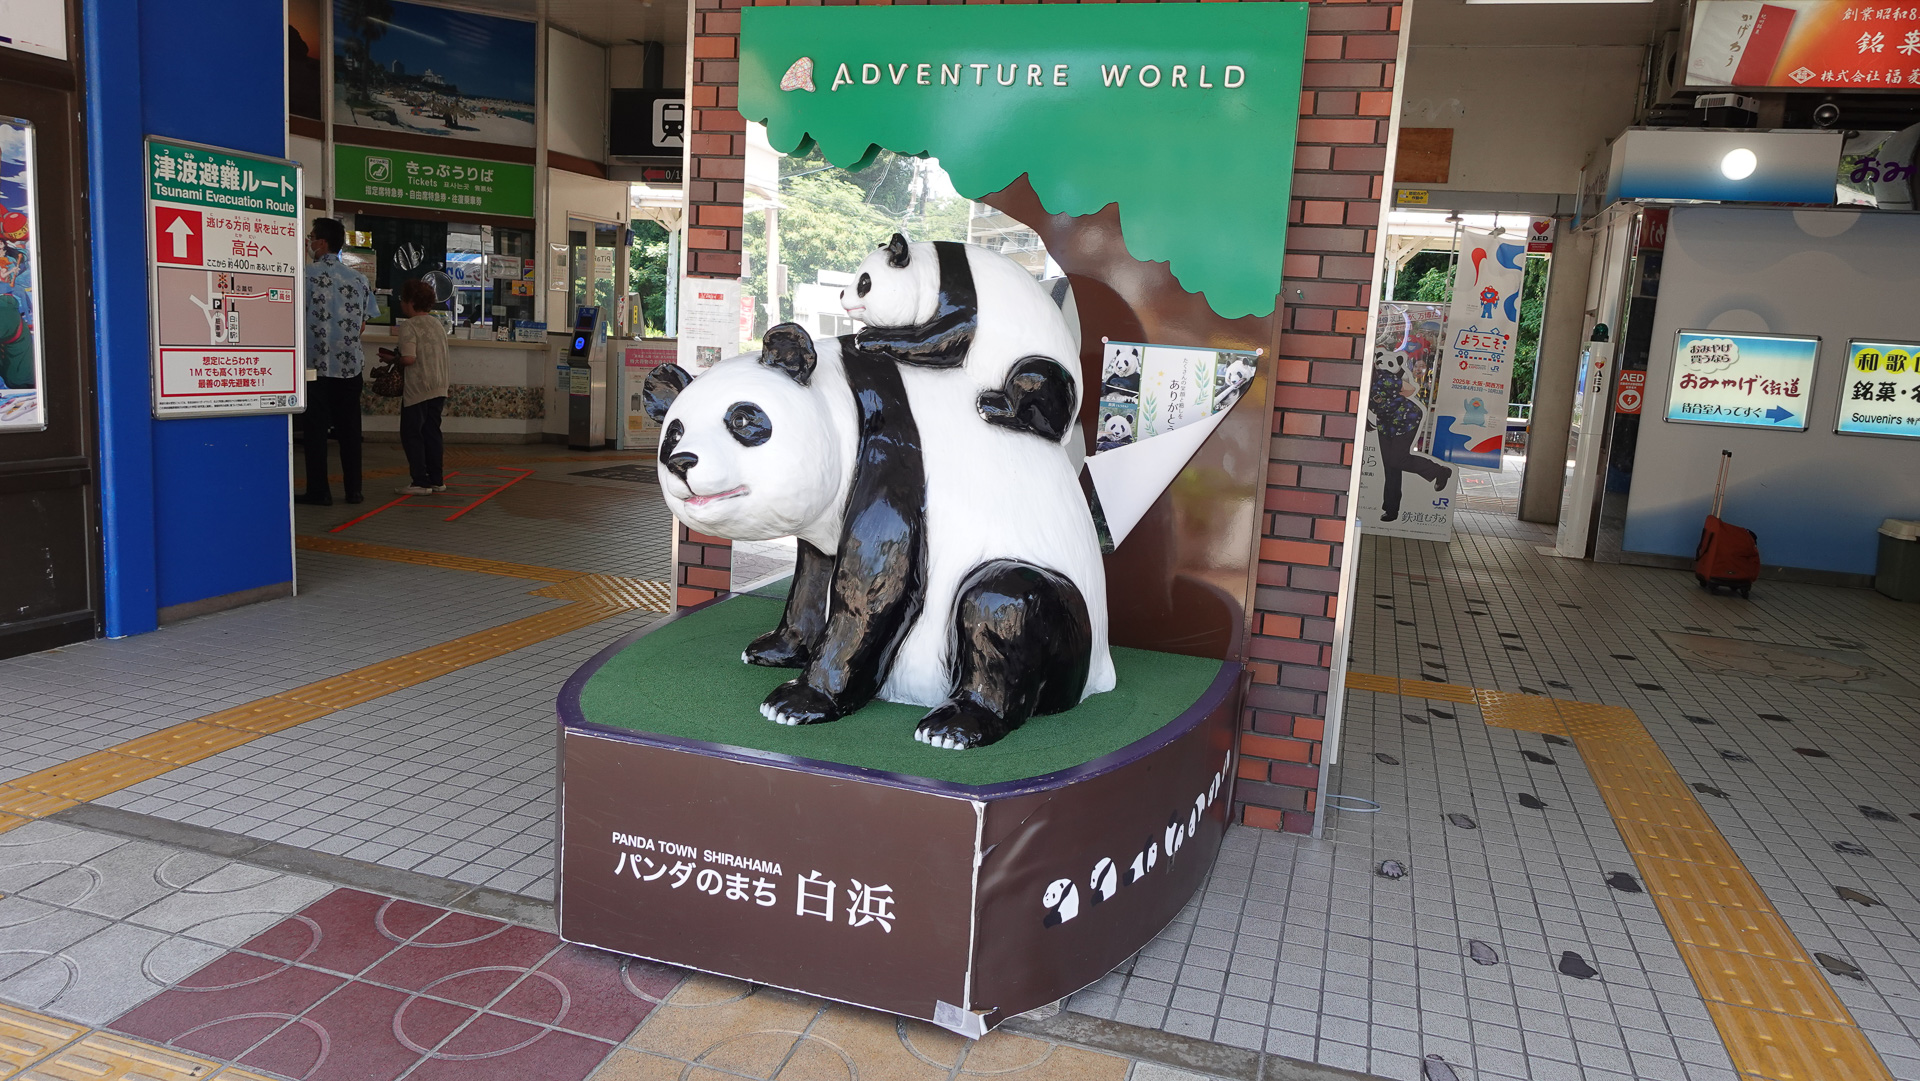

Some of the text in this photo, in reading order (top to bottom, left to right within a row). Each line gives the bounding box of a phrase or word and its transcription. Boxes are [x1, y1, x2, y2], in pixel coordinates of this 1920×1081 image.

[1842, 7, 1920, 21] 創業昭和8
[831, 62, 1246, 92] ADVENTURE WORLD
[1820, 70, 1881, 83] 株式会社
[154, 154, 294, 197] 津波避難ルート
[406, 160, 494, 183] きっぷうりば
[407, 176, 438, 188] Tickets
[154, 182, 295, 213] Tsunami Evacuation Route
[206, 216, 295, 237] 逃げる方向 駅を出て右
[232, 239, 273, 258] 高台へ
[206, 259, 227, 268] ここから
[256, 263, 276, 272] あるいて
[214, 300, 220, 308] P
[1461, 334, 1501, 350] ようこそ
[1690, 343, 1732, 354] おみやげ
[202, 356, 260, 366] 想定にとらわれず
[1592, 370, 1602, 393] AED
[1620, 373, 1645, 383] AED
[1680, 372, 1802, 399] おみやげ街道
[1681, 402, 1762, 419] 待合室入ってすぐ
[1851, 412, 1903, 425] Souvenirs
[1432, 497, 1449, 507] JR
[1401, 511, 1447, 524] 鉄道むすめ
[612, 832, 783, 876] PANDA TOWN SHIRAHAMA
[614, 851, 896, 934] パンダのまち 白浜
